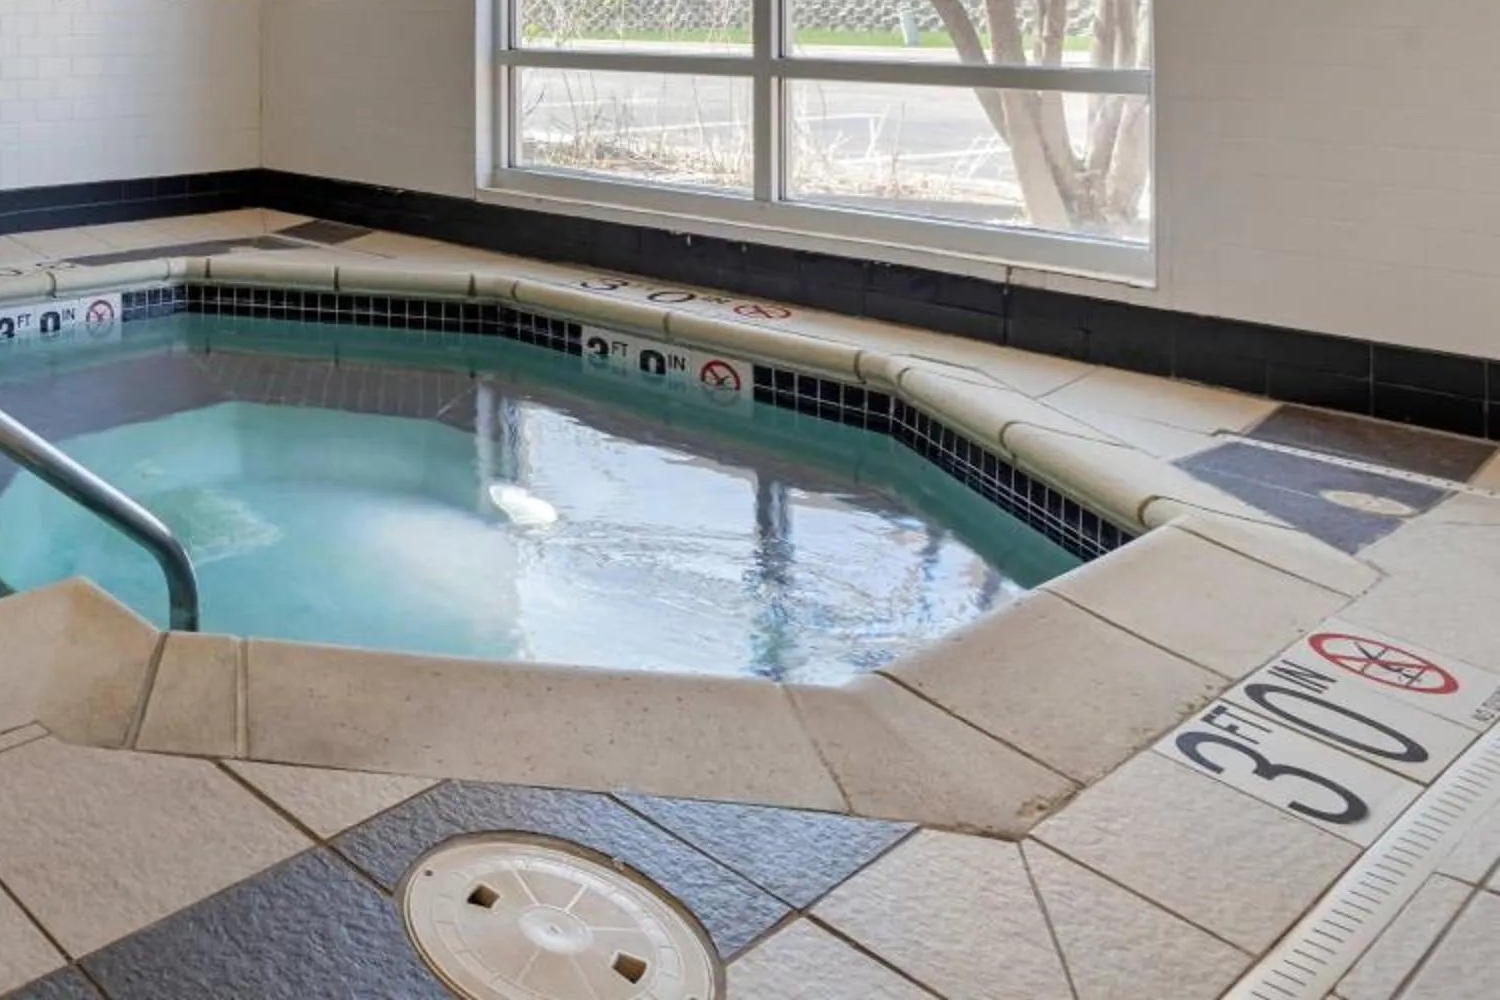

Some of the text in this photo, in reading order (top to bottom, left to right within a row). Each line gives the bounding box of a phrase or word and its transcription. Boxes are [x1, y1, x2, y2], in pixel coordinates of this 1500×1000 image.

[17, 313, 31, 329] FT
[62, 308, 75, 321] IN
[611, 341, 628, 356] FT
[668, 353, 685, 371] IN
[1175, 659, 1429, 825] 3 FT 0 IN
